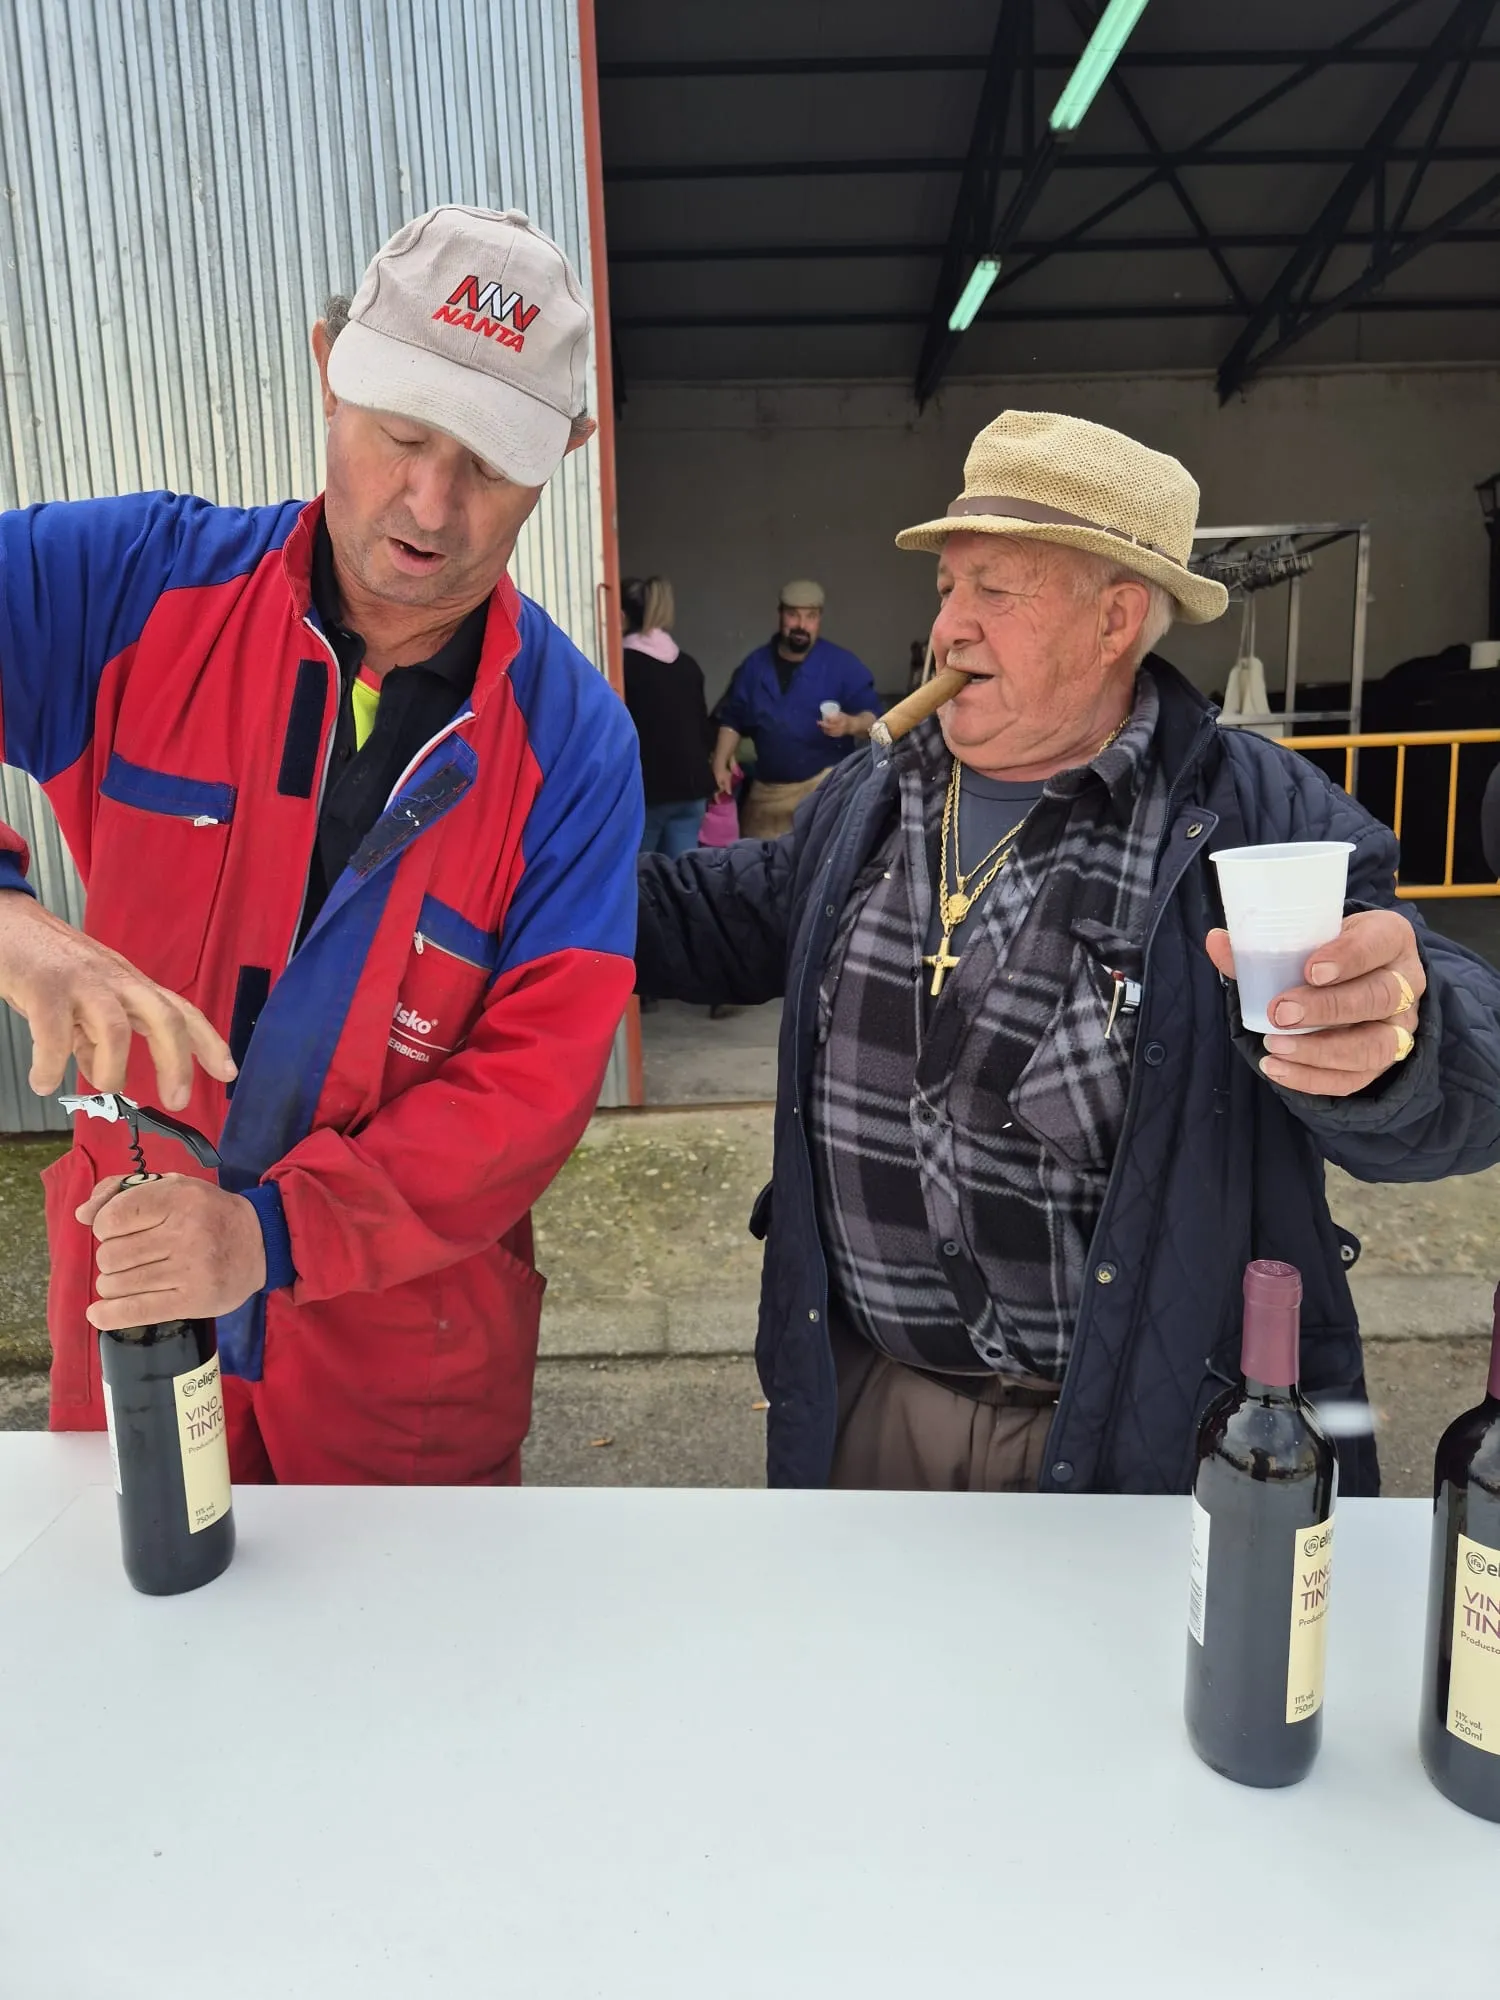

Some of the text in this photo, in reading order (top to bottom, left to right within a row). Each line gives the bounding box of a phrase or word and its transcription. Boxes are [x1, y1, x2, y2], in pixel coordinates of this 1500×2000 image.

[432, 305, 525, 353] NANTA
[185, 1396, 218, 1421] VINO
[1455, 1710, 1468, 1723] 11%
[1455, 1720, 1482, 1741] 750ml
